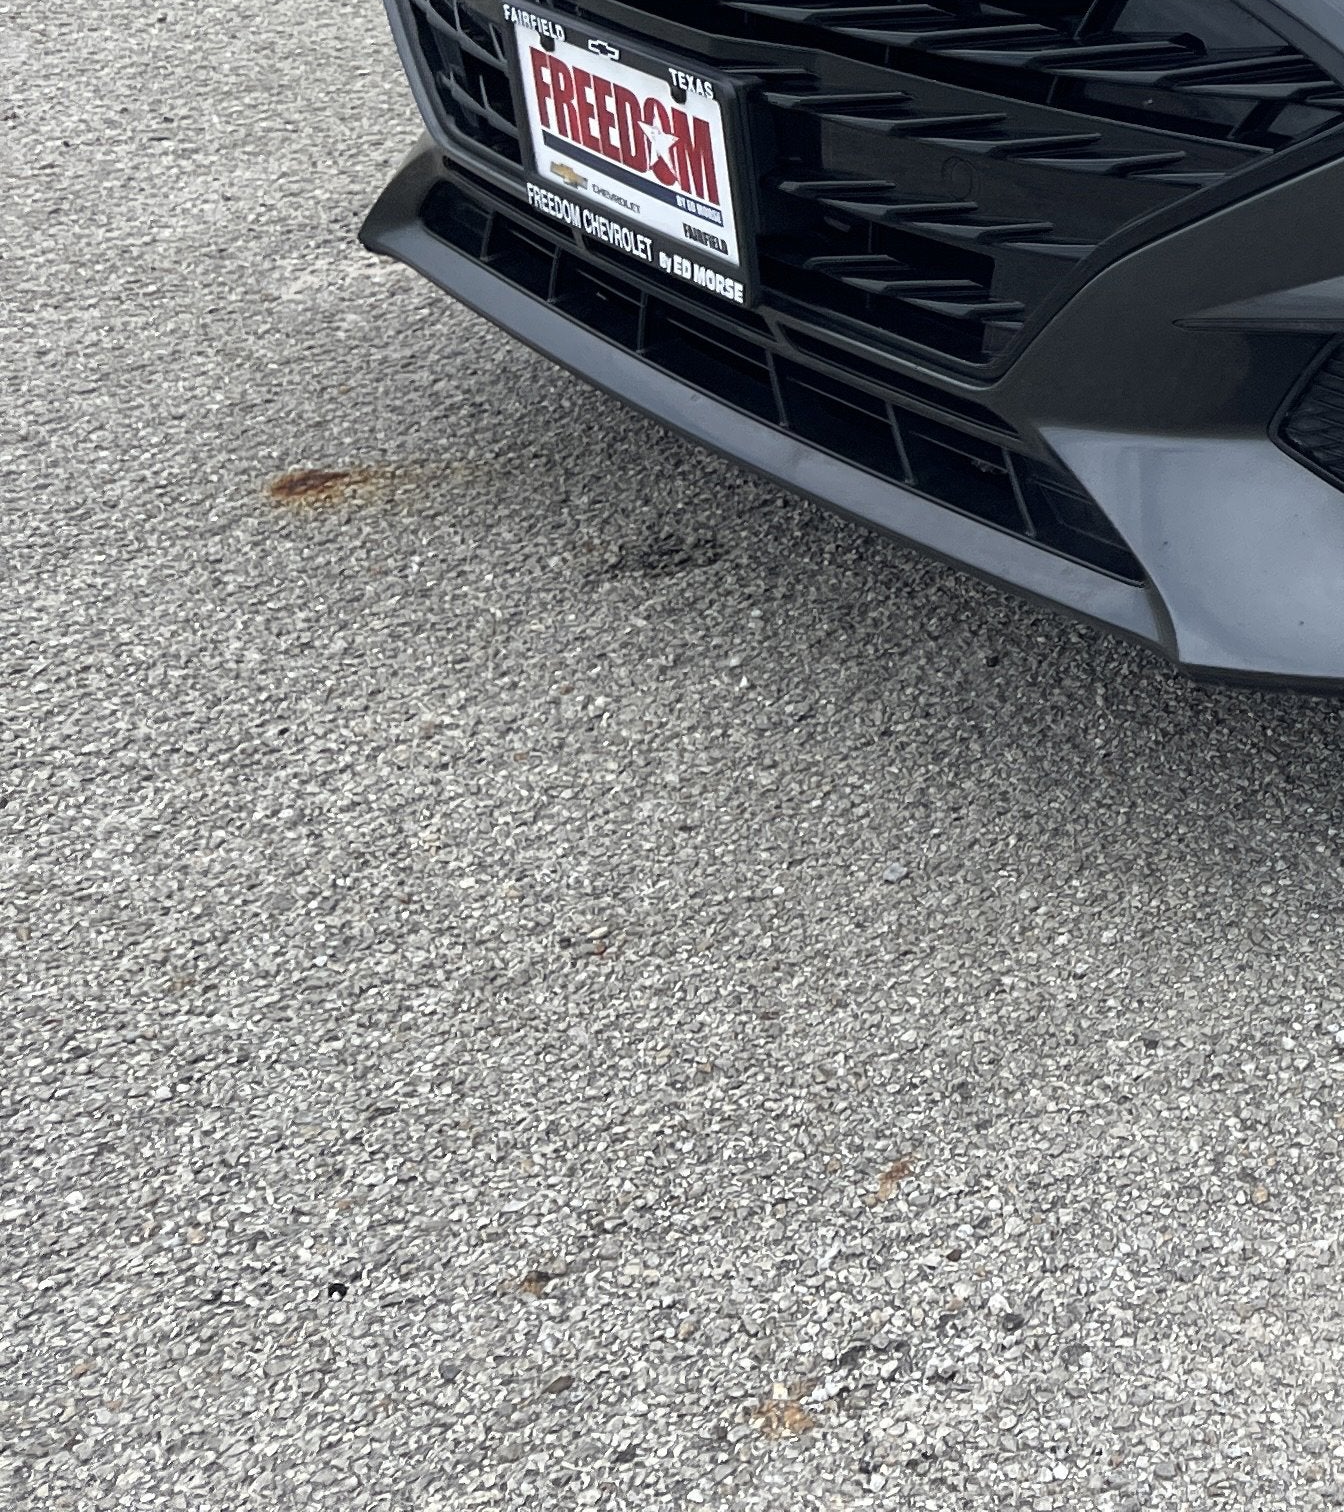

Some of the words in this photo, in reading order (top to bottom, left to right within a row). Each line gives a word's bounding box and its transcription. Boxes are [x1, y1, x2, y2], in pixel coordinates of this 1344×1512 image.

[502, 3, 566, 43] FAIRFIELD
[668, 67, 715, 100] TEXAS
[529, 45, 720, 207] FREEDOM
[526, 182, 582, 229] FREEDOM
[582, 208, 653, 263] CHEVROLET
[673, 254, 692, 280] ED
[693, 263, 744, 304] MORSE
